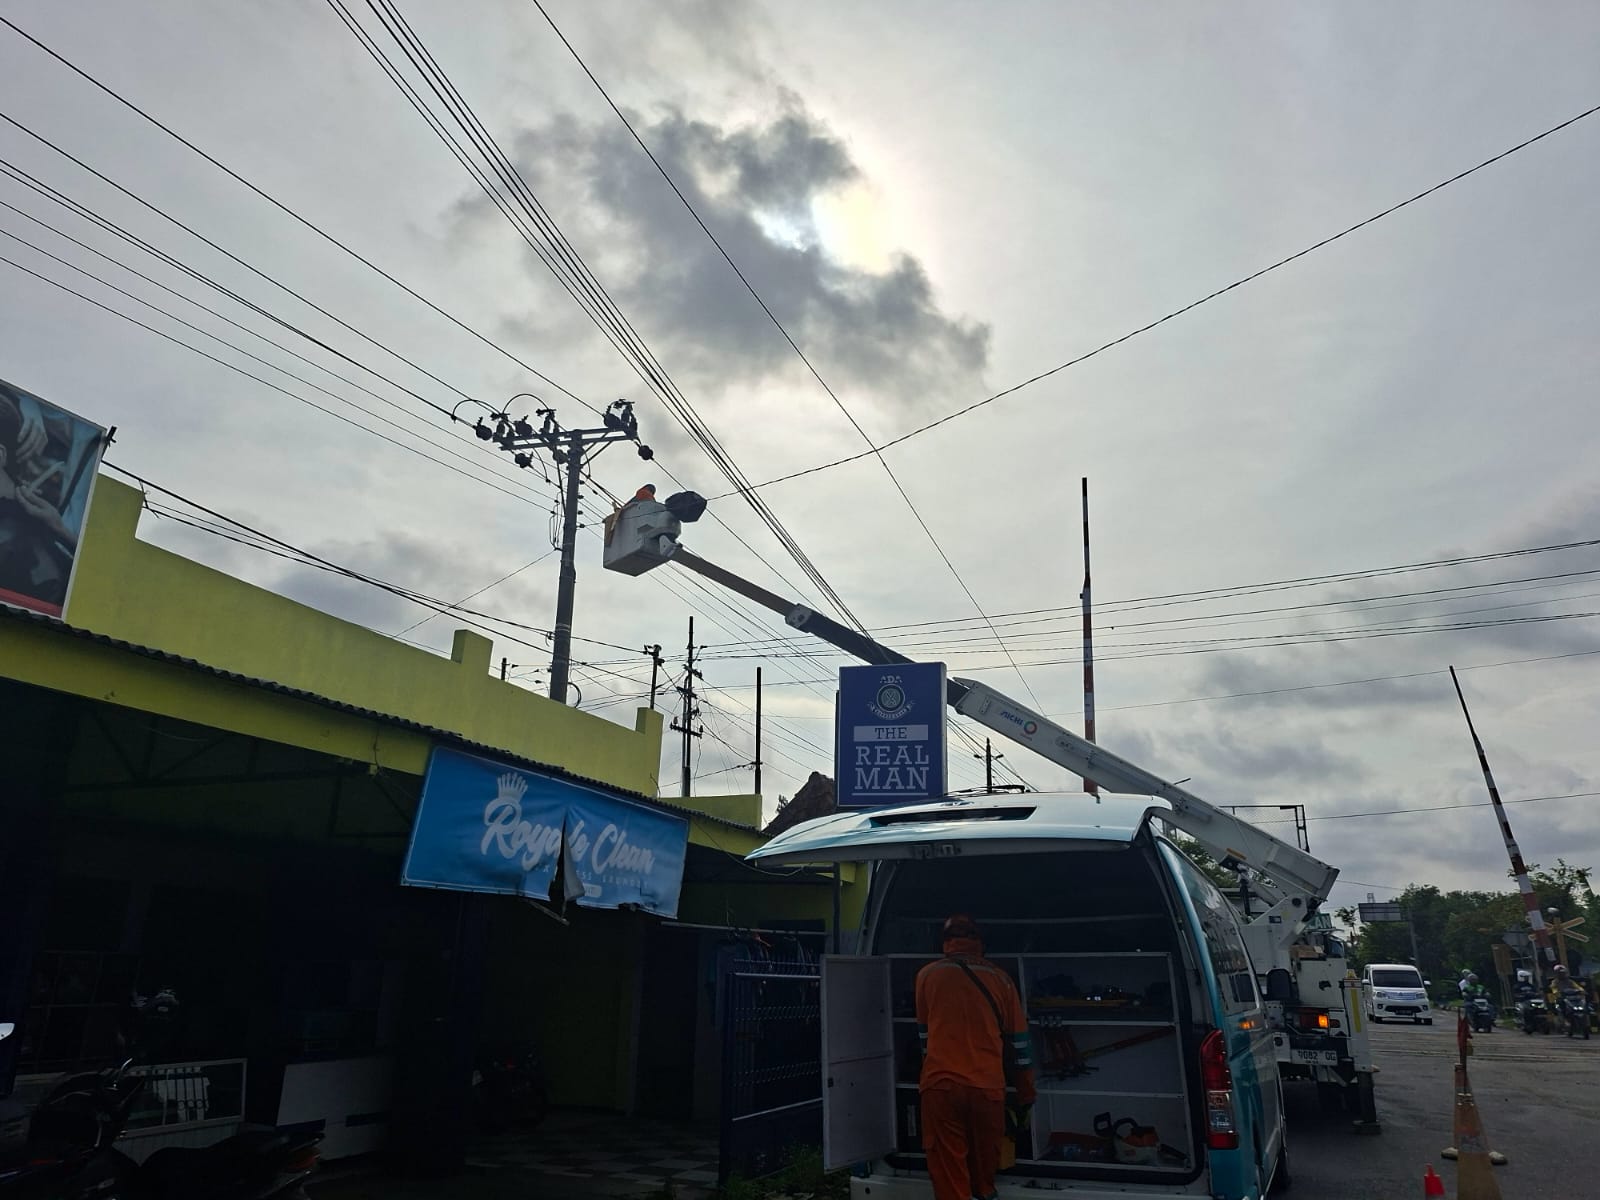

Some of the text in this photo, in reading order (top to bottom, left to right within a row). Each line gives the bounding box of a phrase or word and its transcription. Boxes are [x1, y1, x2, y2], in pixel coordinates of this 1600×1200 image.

[1000, 711, 1024, 725] AICHI
[875, 727, 908, 739] THE
[855, 745, 929, 765] REAL
[854, 767, 929, 790] MAN
[592, 823, 655, 875] Clean
